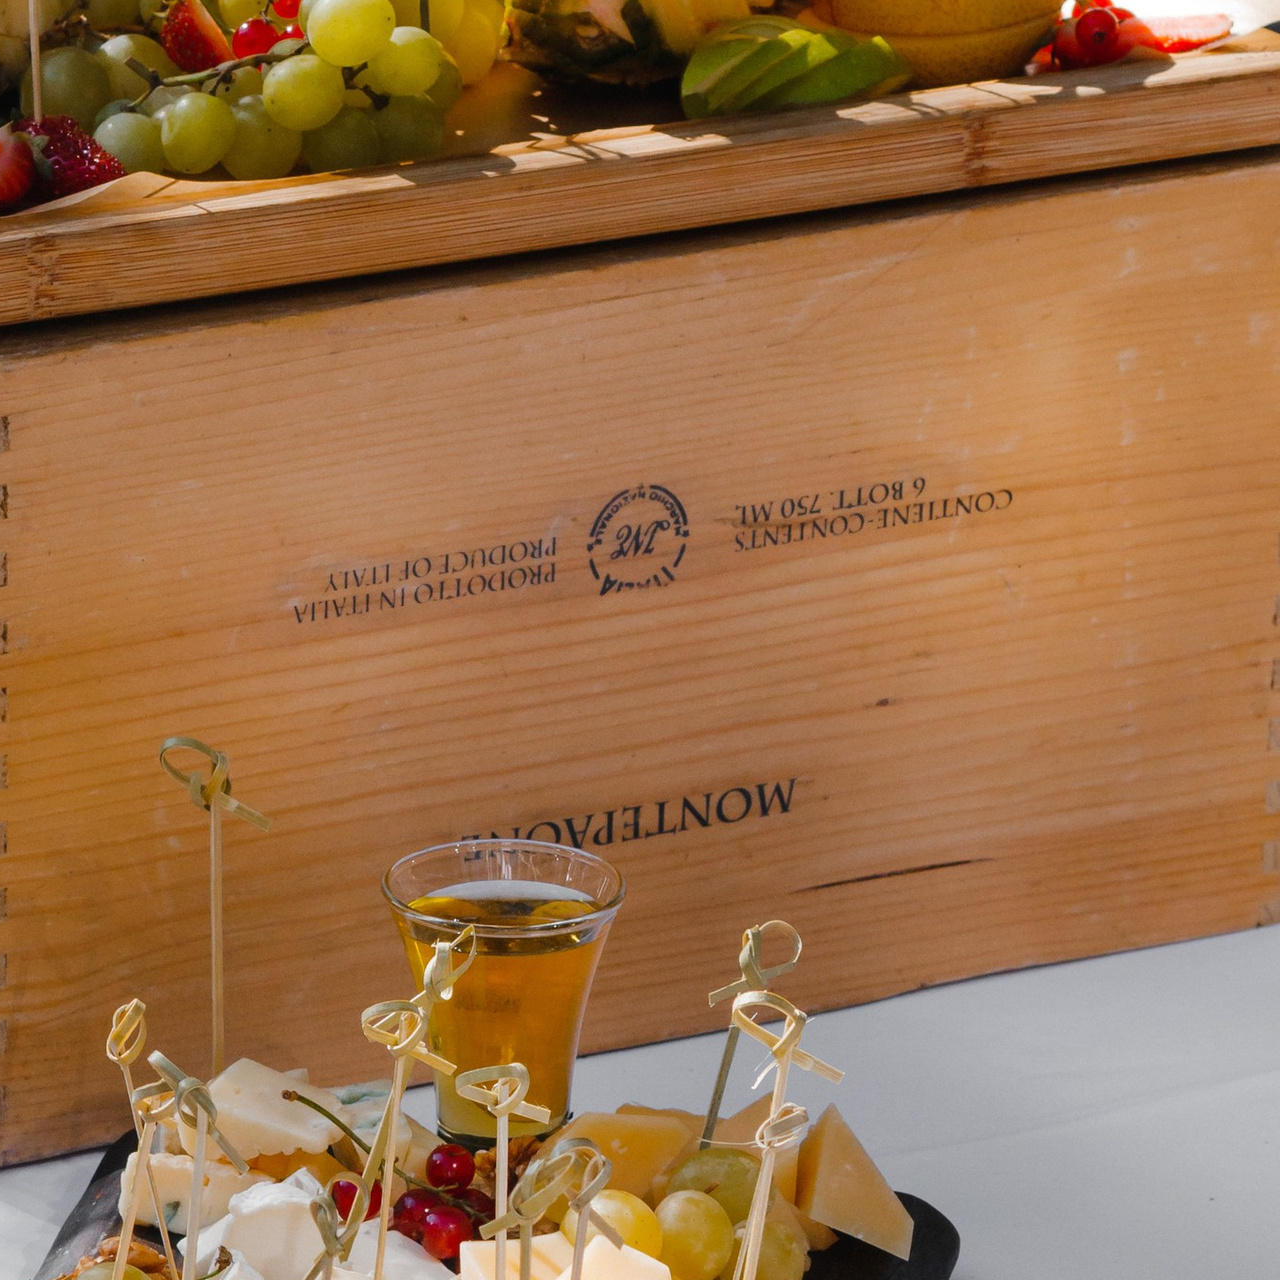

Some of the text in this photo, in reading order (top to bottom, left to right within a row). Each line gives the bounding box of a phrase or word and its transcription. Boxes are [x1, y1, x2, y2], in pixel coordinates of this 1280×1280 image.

[780, 493, 821, 518] 750
[830, 482, 904, 512] BOTT.
[912, 477, 927, 496] 6
[734, 488, 1014, 553] CONTIENE-CONTENTS
[323, 535, 558, 594] PRODUCE OF ITALY
[293, 562, 557, 624] PRODOTTO IN ITALIA
